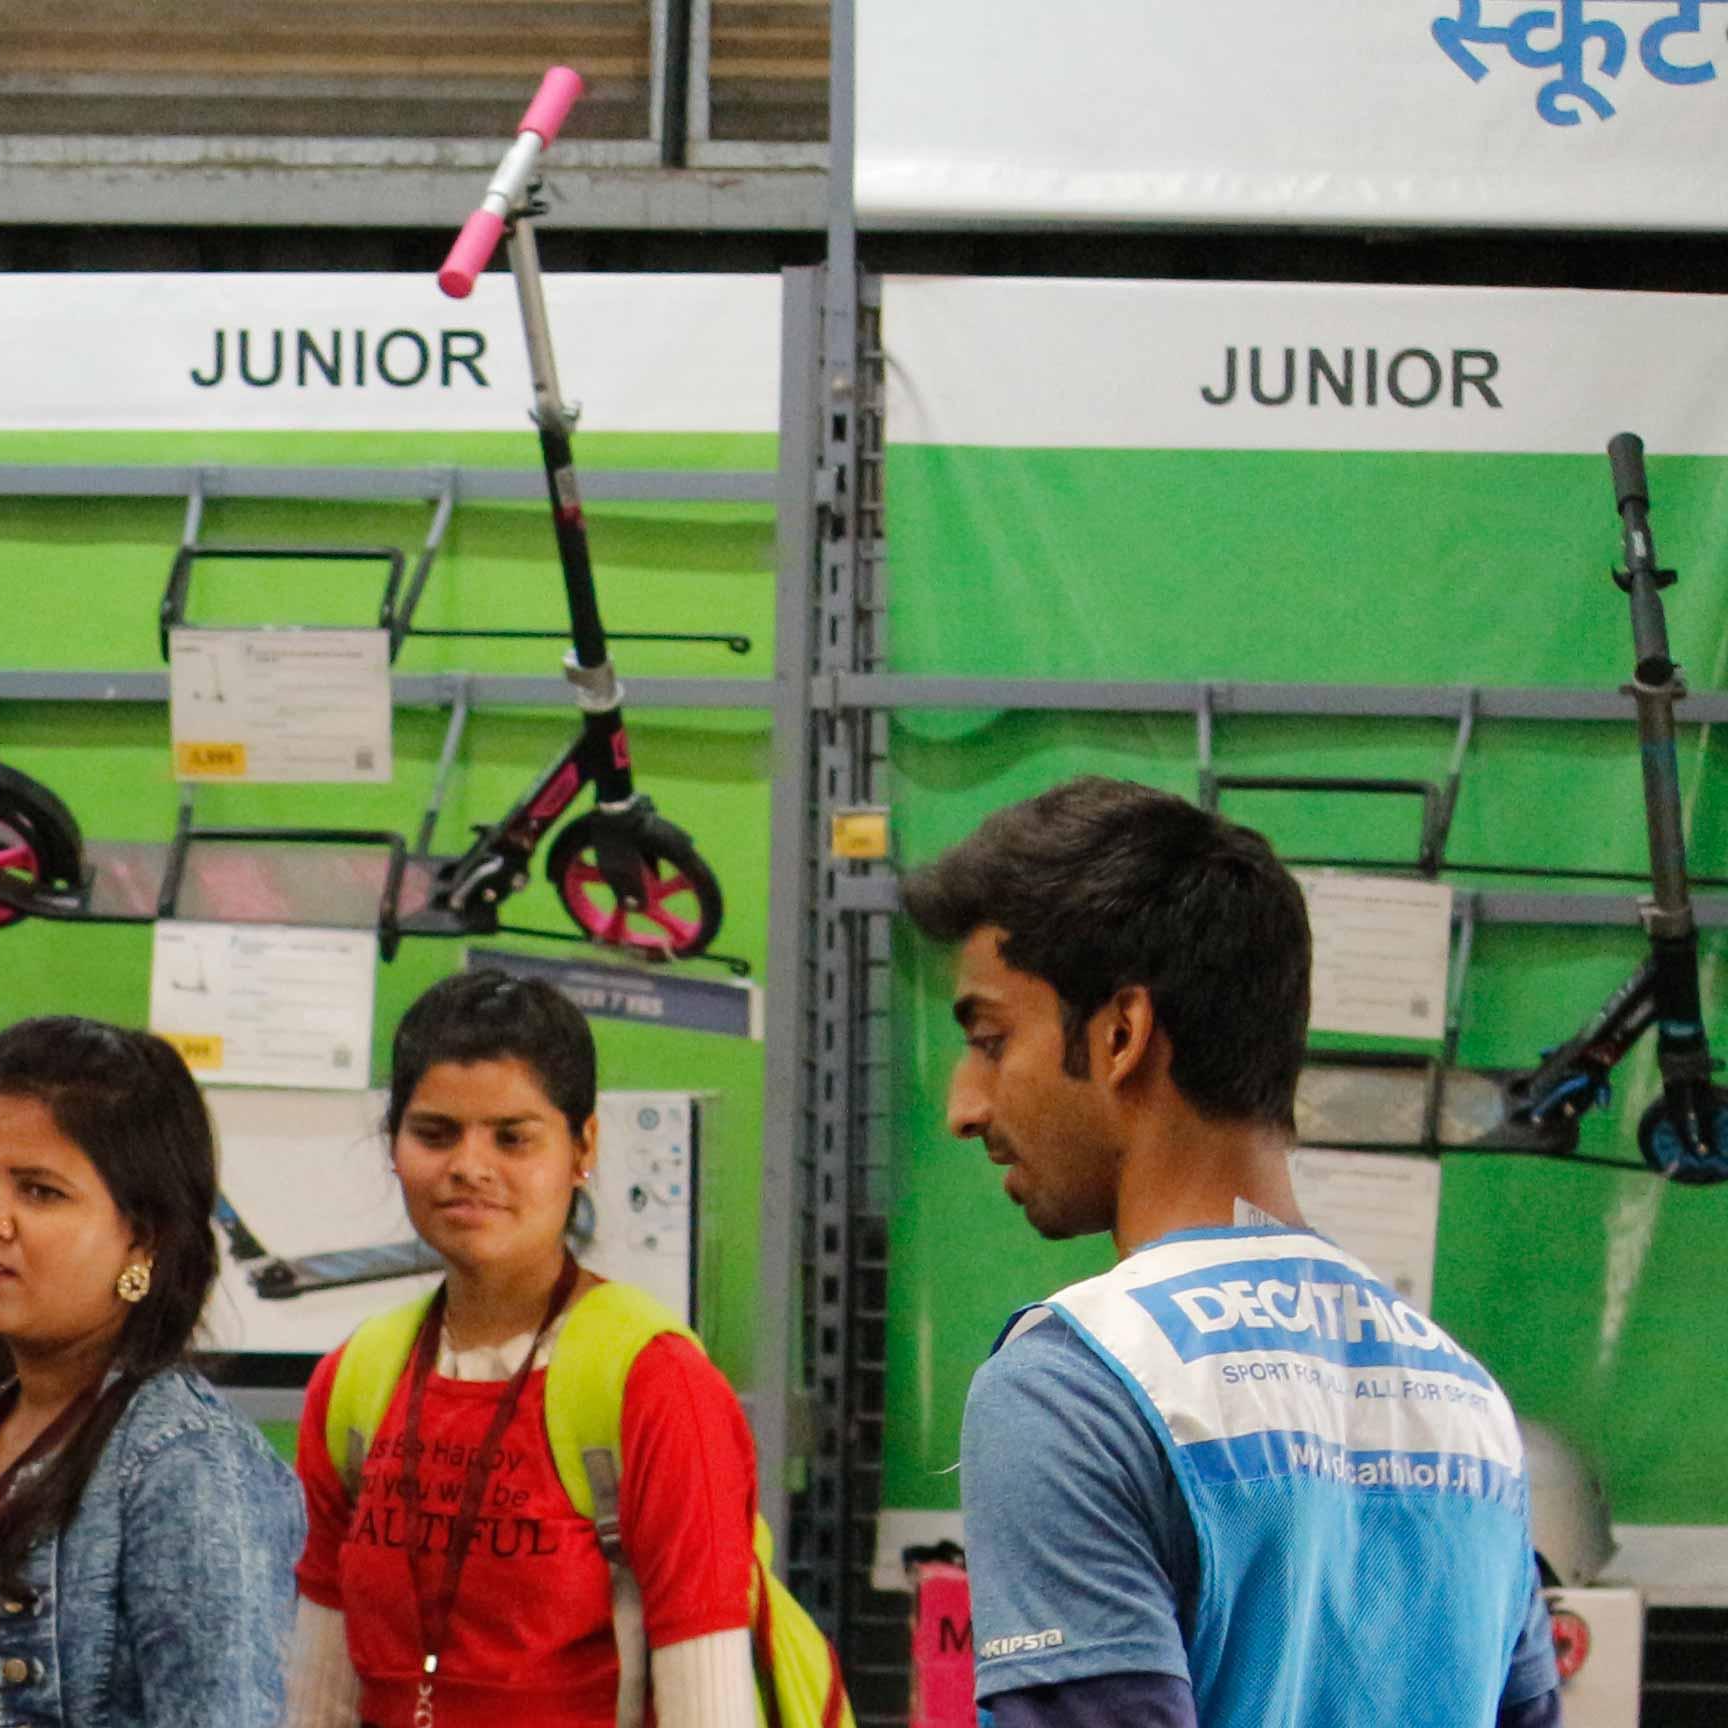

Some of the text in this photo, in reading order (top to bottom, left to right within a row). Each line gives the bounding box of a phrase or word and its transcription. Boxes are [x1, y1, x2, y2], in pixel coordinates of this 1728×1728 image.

[1431, 0, 1728, 126] स्कूट
[190, 328, 491, 388] JUNIOR
[1199, 346, 1504, 409] JUNIOR
[1222, 1362, 1290, 1384] SPORT
